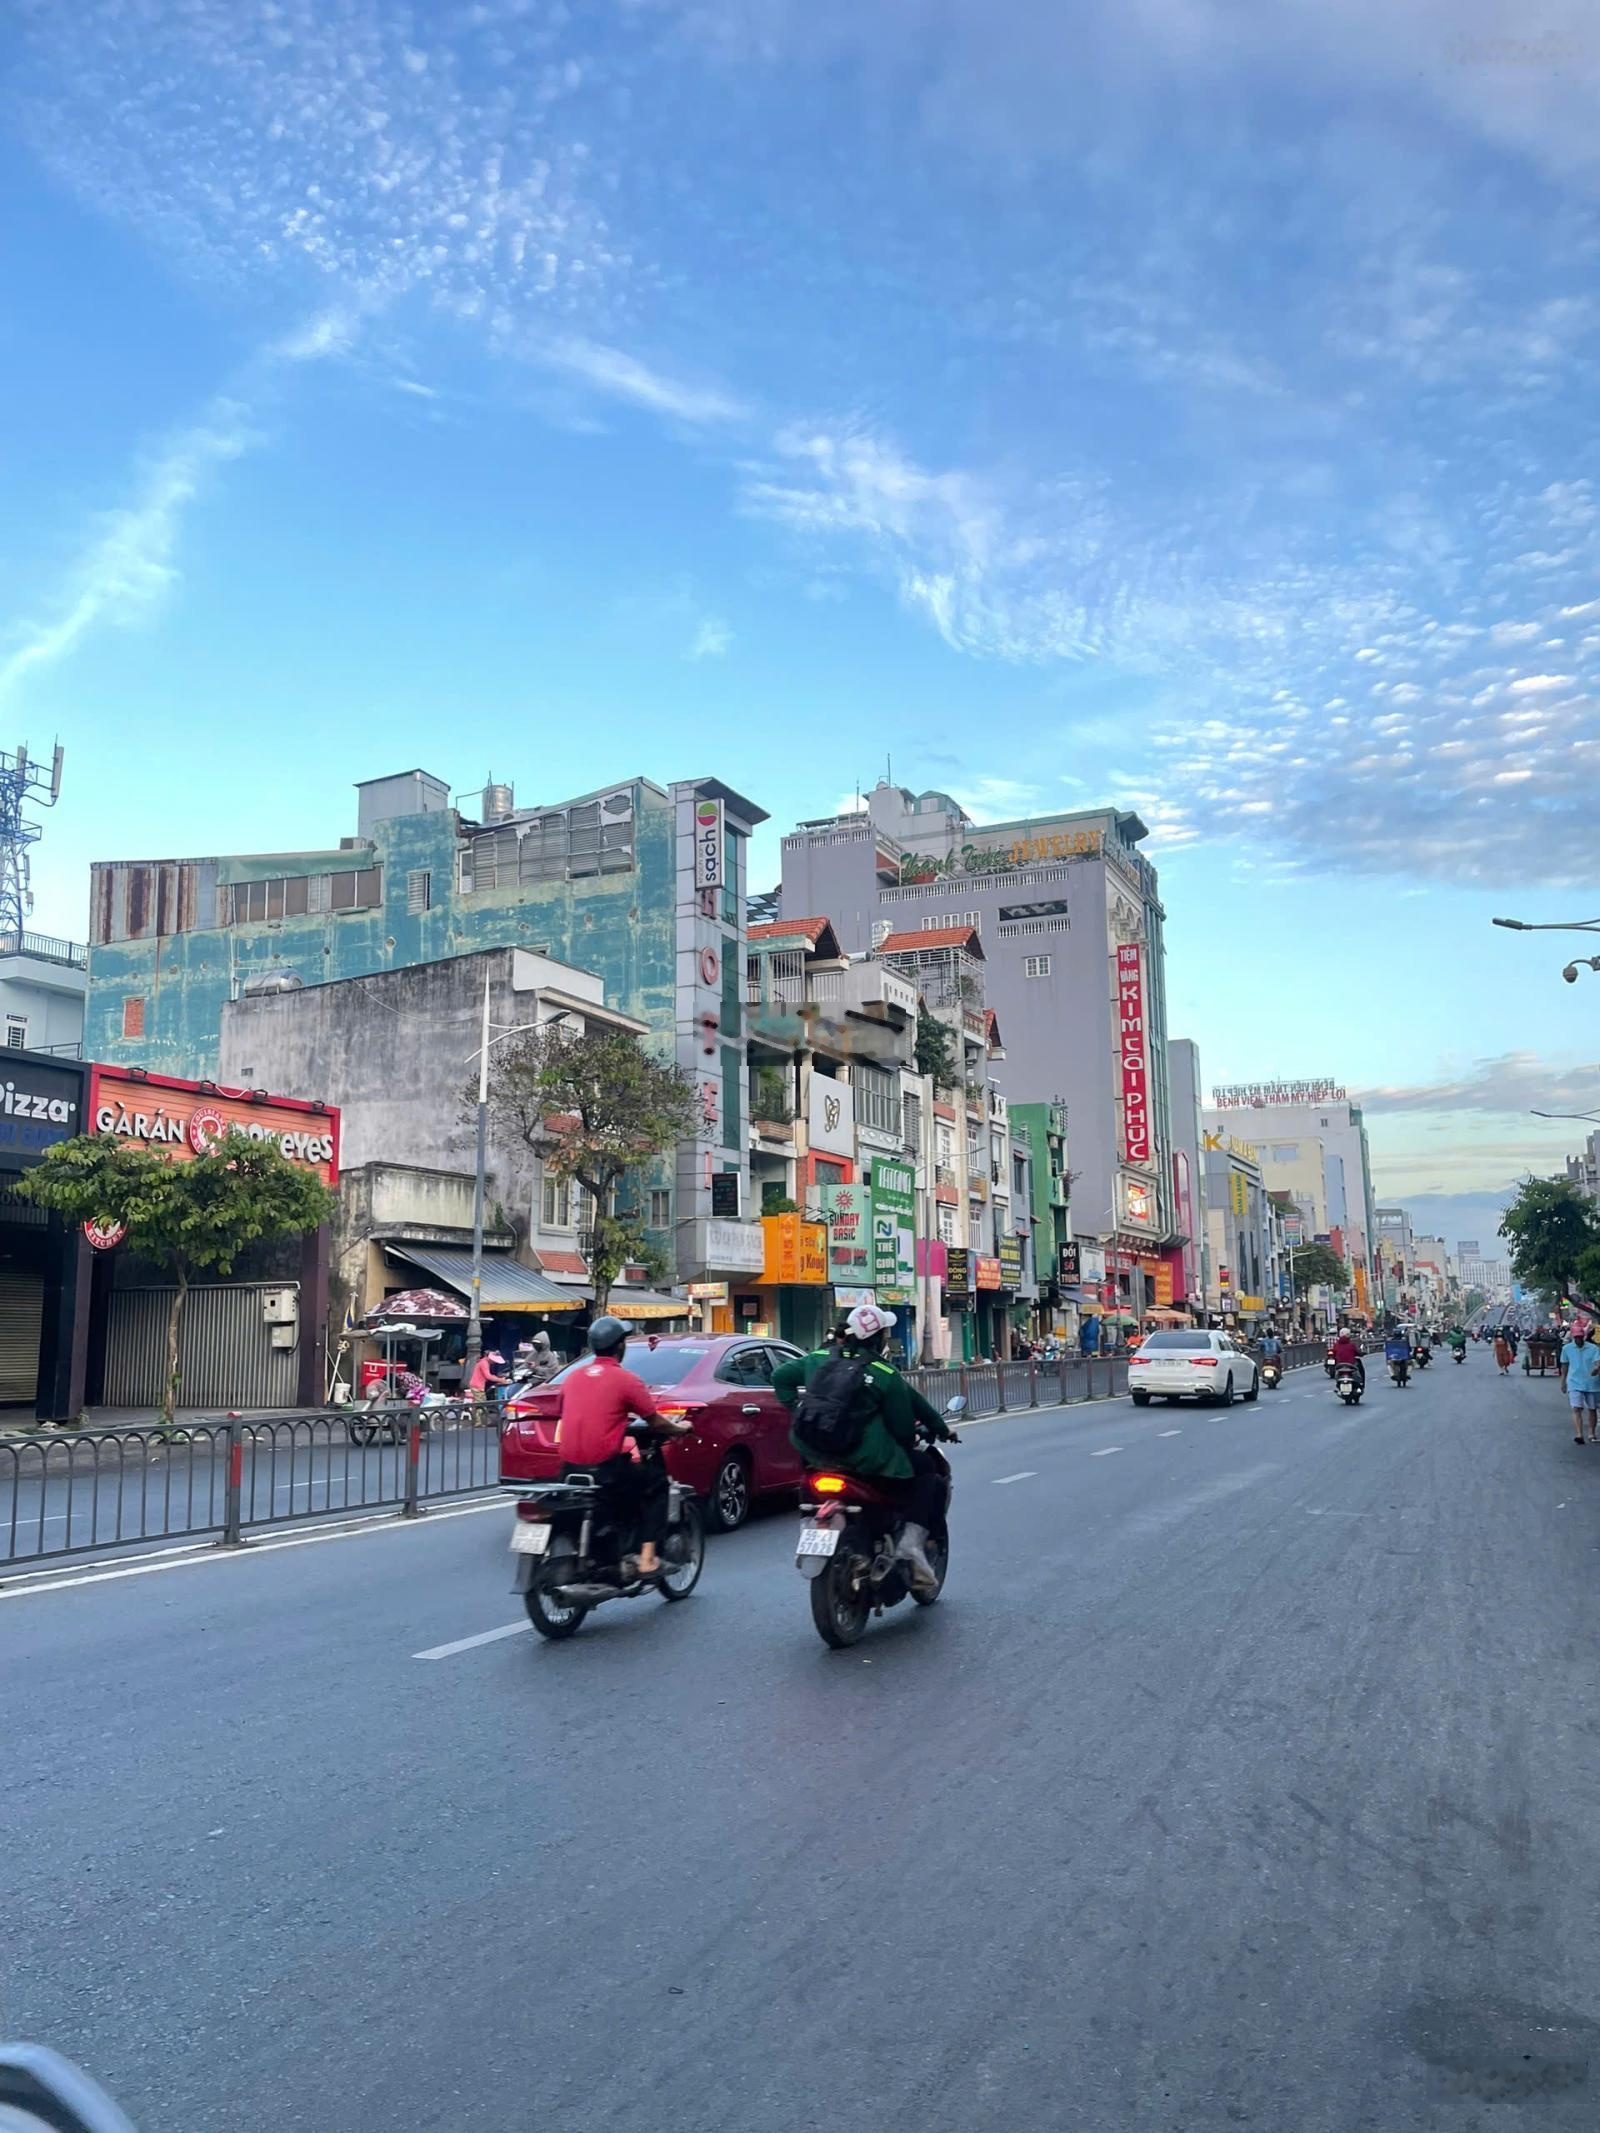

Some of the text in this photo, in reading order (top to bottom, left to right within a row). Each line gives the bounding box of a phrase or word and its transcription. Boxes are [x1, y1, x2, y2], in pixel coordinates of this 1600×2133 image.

[1007, 830, 1101, 864] JEWELRY
[1121, 986, 1141, 1032] KIM
[829, 1212, 860, 1227] SUNDAY
[833, 1227, 856, 1241] BASIC
